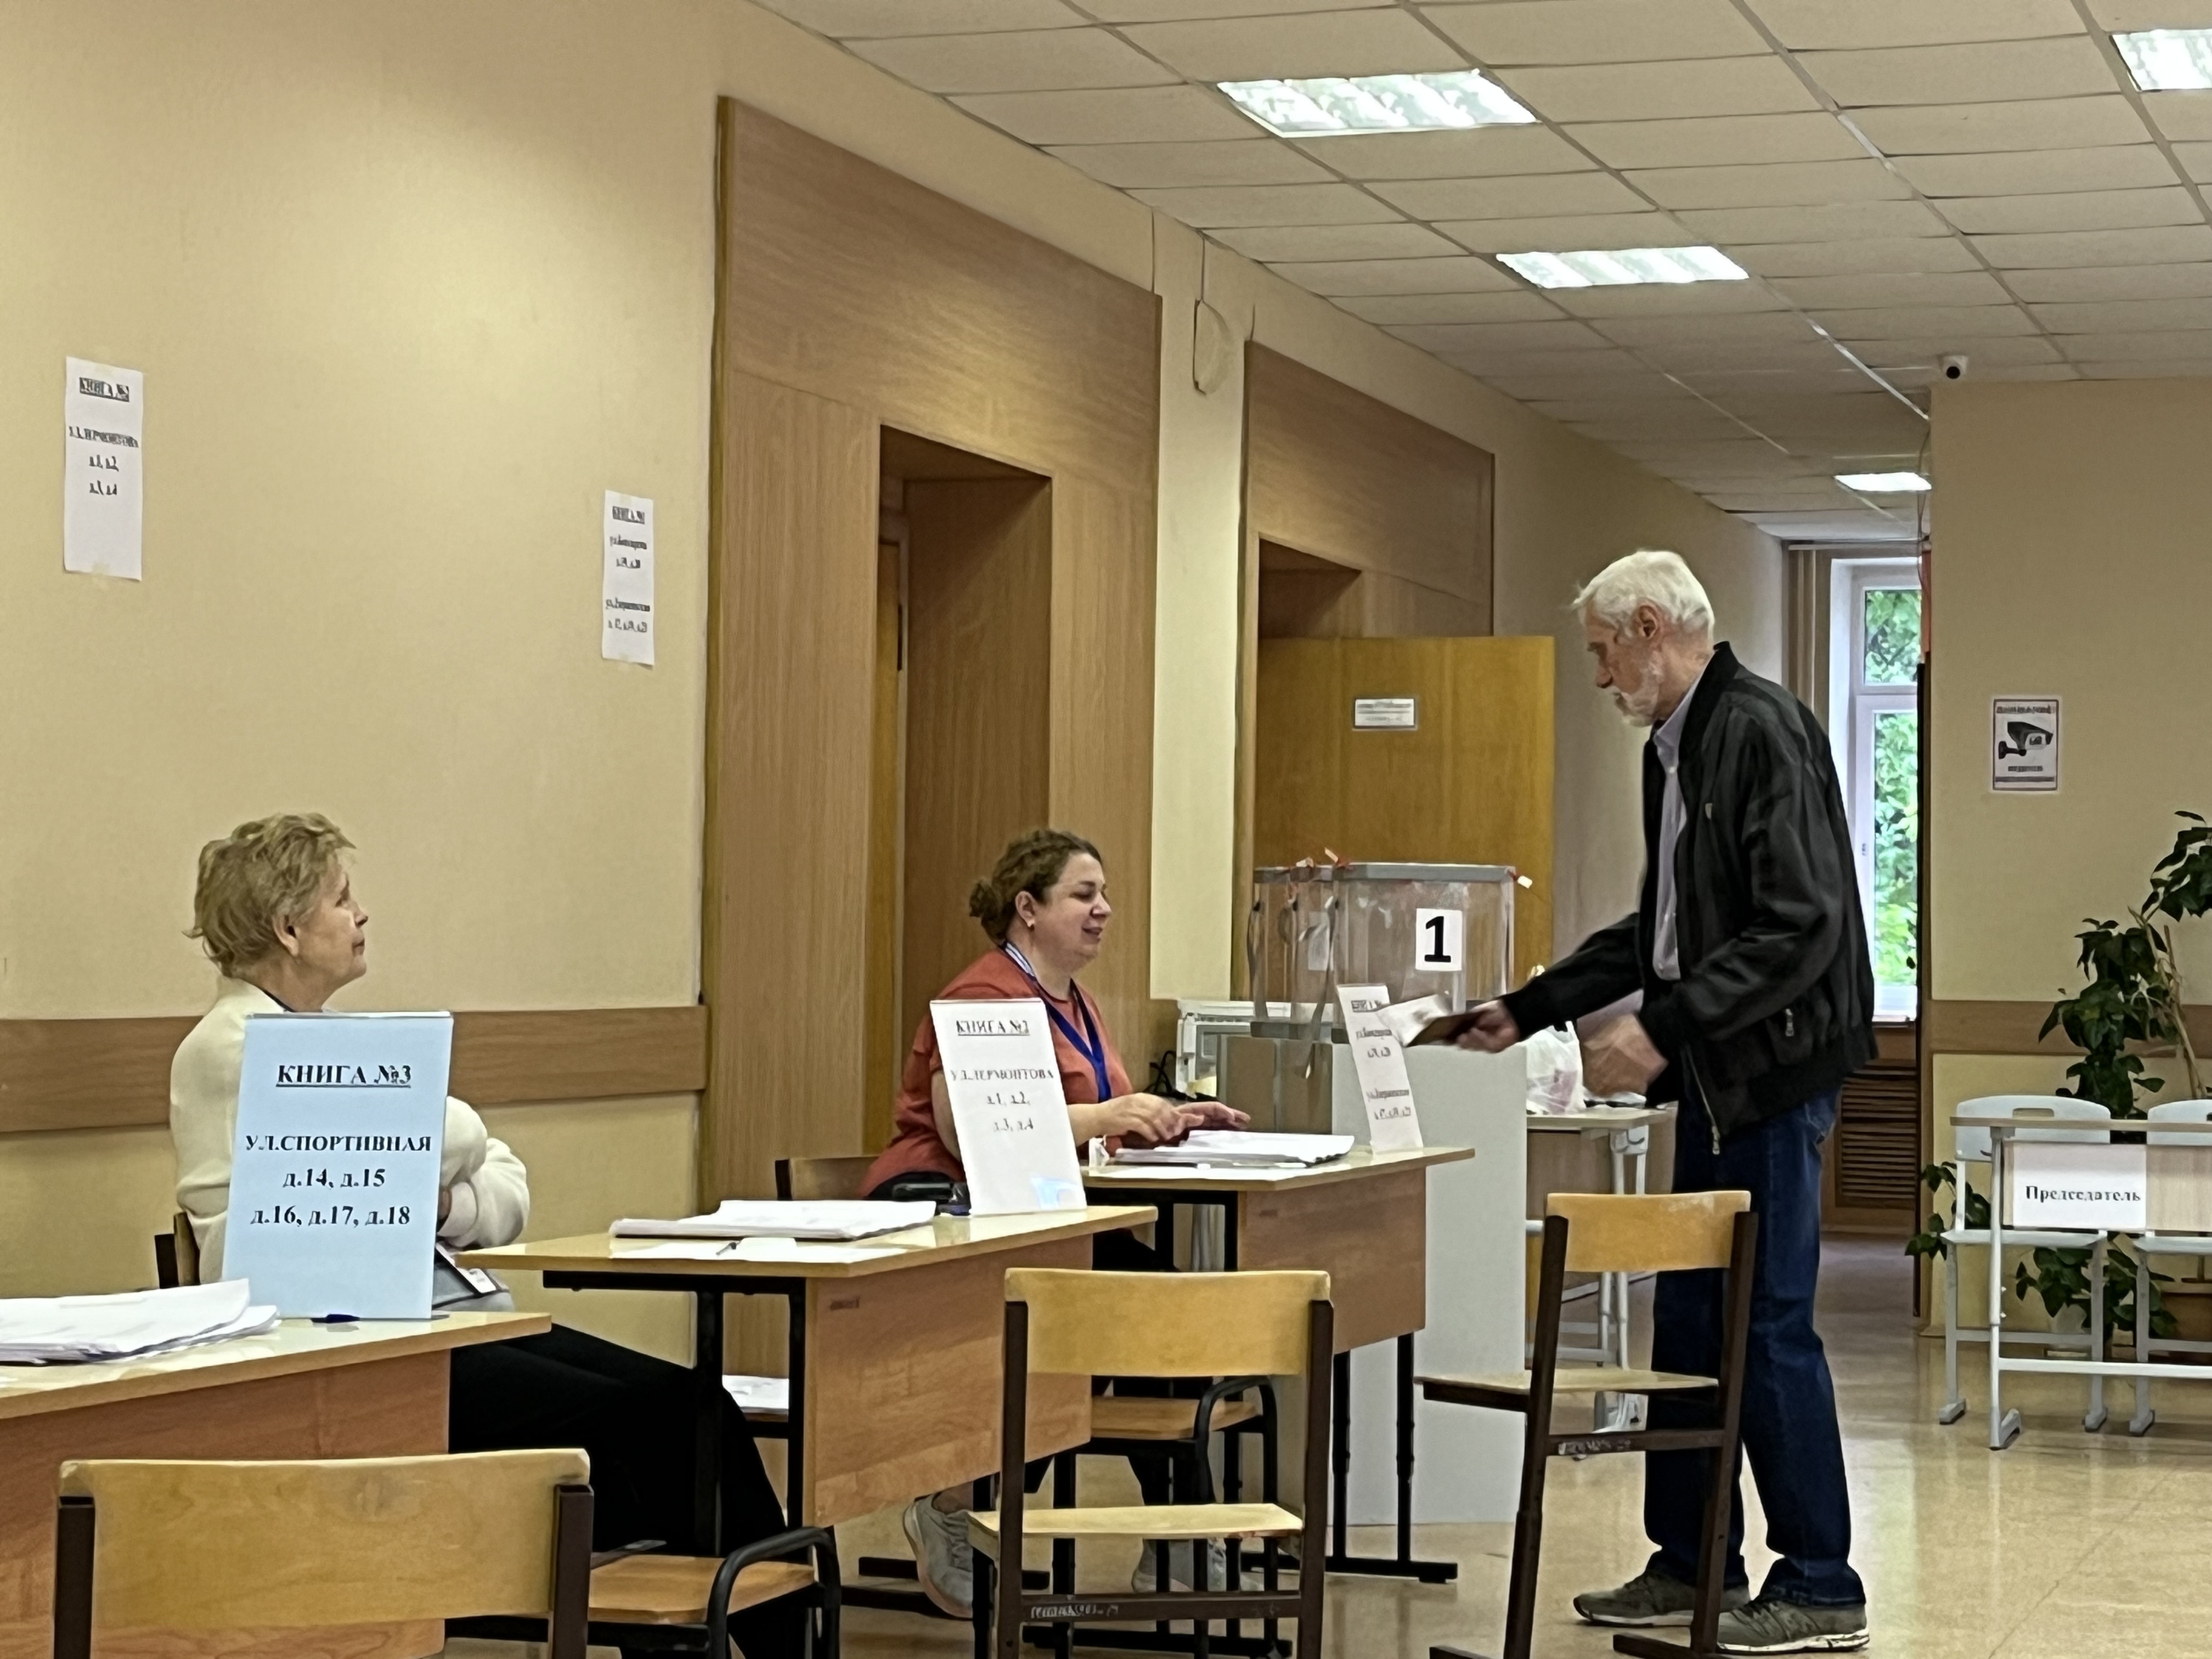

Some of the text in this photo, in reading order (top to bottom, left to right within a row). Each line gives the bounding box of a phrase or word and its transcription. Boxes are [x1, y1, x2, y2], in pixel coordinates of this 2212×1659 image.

[1425, 916, 1452, 963] 1
[277, 1065, 411, 1084] КНИГА №3
[283, 1168, 386, 1189] д.14, д.15
[2025, 1186, 2141, 1203] Председатель
[250, 1205, 411, 1228] д.16, д.17, д.18
